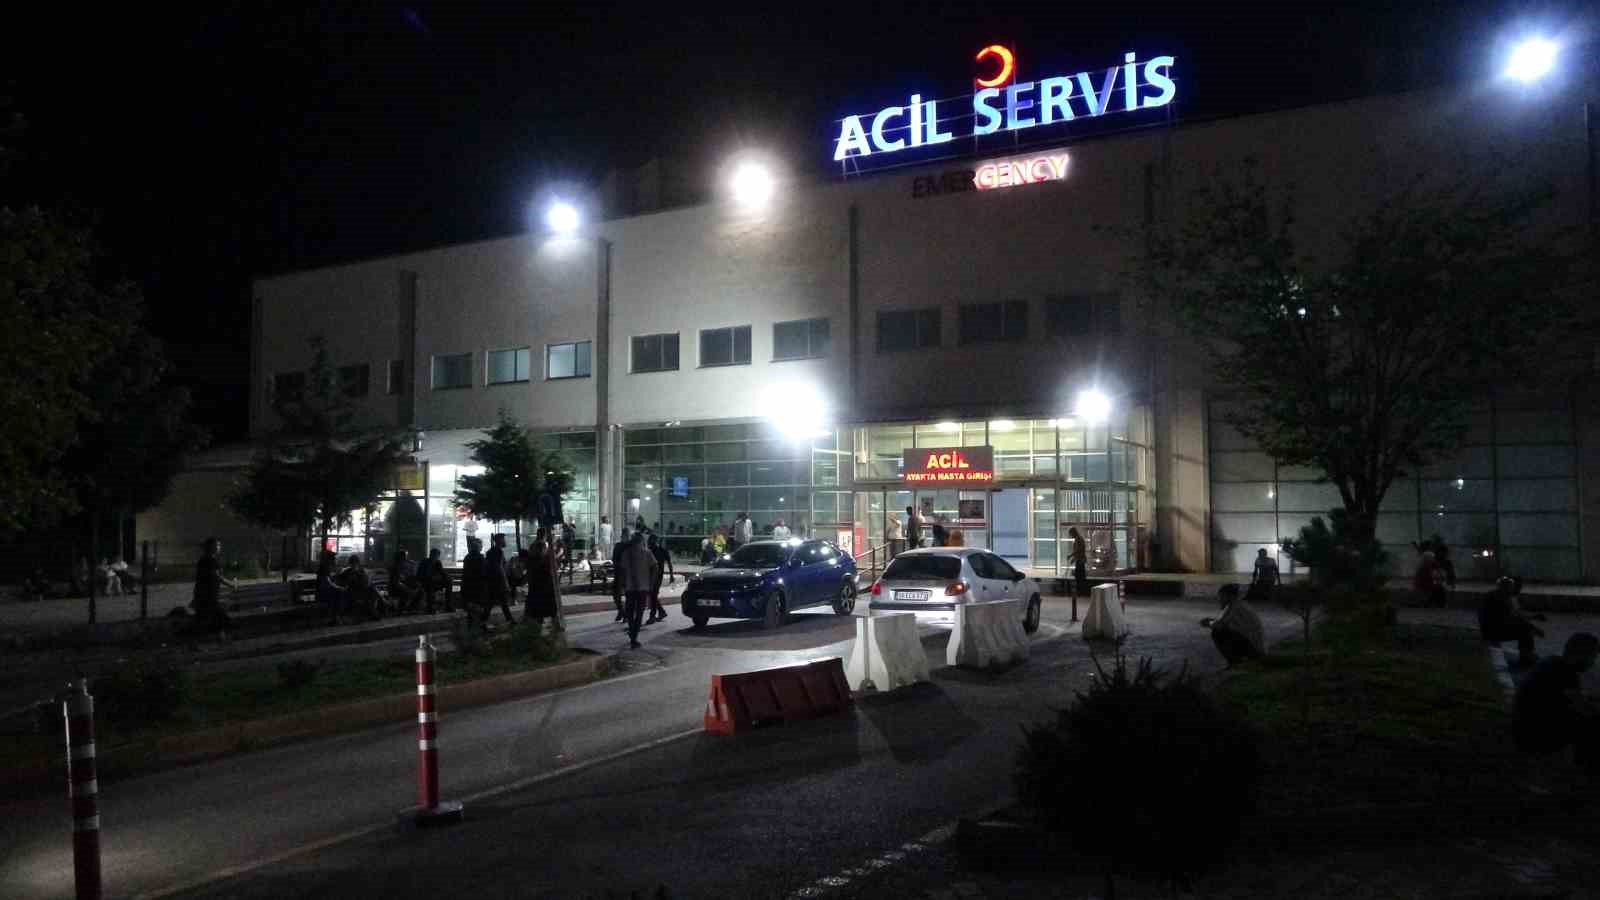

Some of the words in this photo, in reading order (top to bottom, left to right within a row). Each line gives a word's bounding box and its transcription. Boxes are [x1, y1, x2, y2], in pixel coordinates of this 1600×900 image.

[834, 94, 952, 161] ACİL
[974, 52, 1177, 136] SERVİS
[913, 154, 1069, 197] EMERGENCY
[927, 451, 969, 469] ACİL
[938, 472, 965, 481] HASTA
